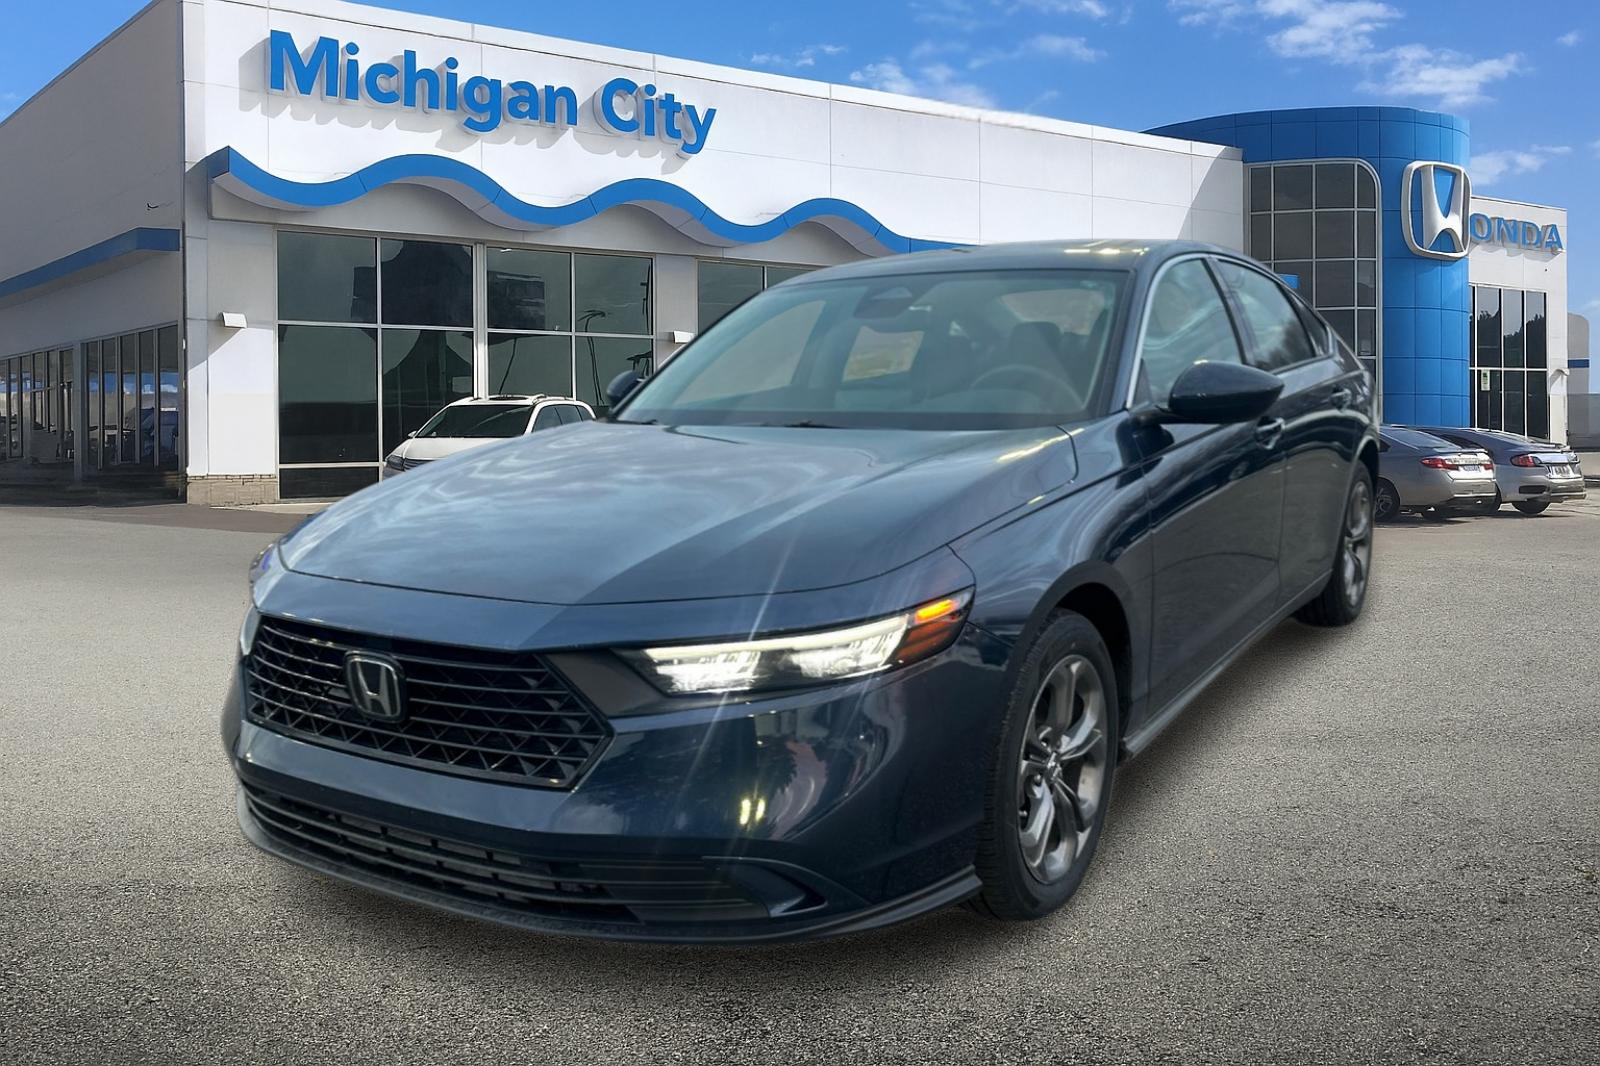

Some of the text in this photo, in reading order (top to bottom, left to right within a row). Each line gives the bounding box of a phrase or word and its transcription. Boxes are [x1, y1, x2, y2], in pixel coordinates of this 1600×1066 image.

[269, 29, 718, 155] Michigan City
[1470, 212, 1564, 250] ONDA
